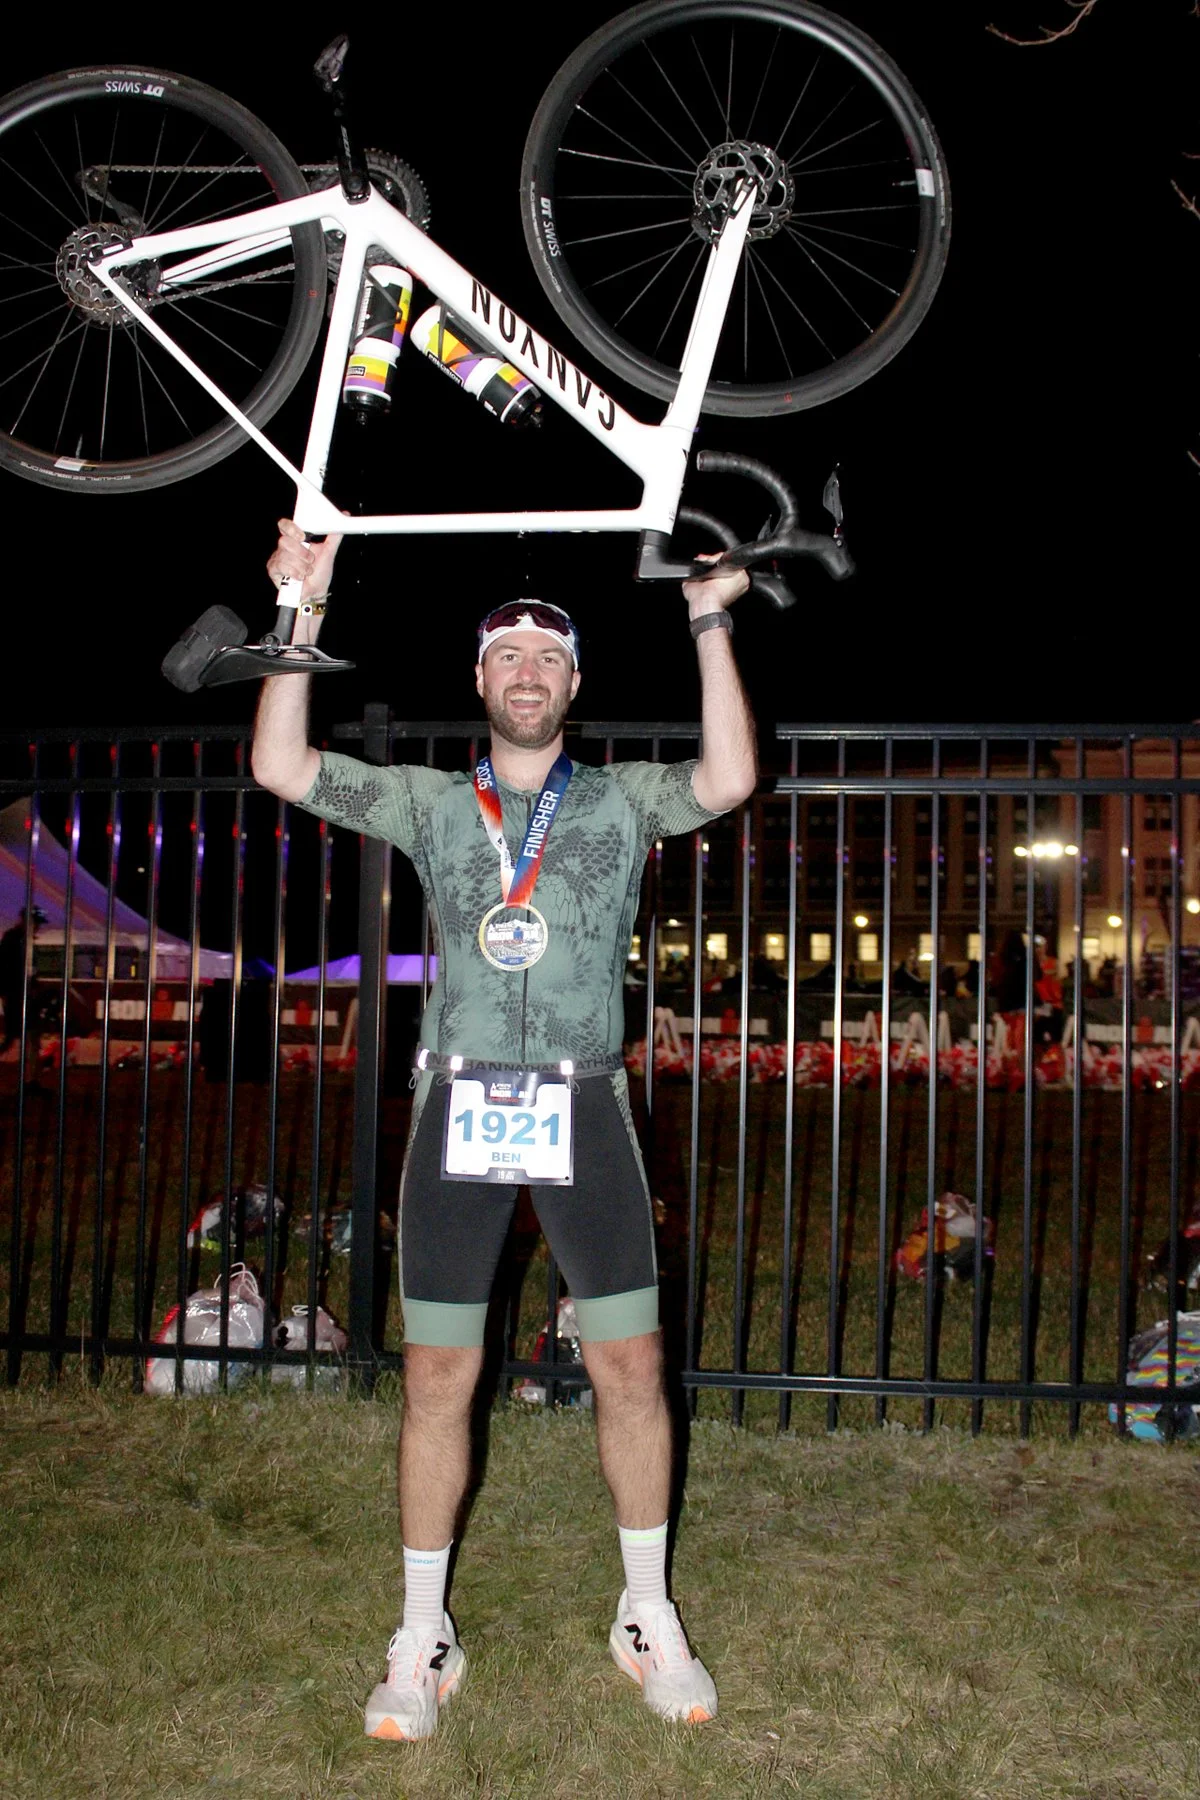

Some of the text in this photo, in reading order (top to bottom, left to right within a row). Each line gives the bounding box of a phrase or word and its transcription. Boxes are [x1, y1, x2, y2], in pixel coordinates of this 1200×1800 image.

[105, 80, 165, 97] DT SWISS
[540, 196, 562, 257] DT SWISS
[471, 276, 617, 432] CANYON
[476, 761, 493, 790] 2026
[523, 790, 560, 858] FINISHER
[504, 1064, 559, 1072] NATHAN
[455, 1109, 560, 1146] 1921
[491, 1151, 521, 1164] BEN
